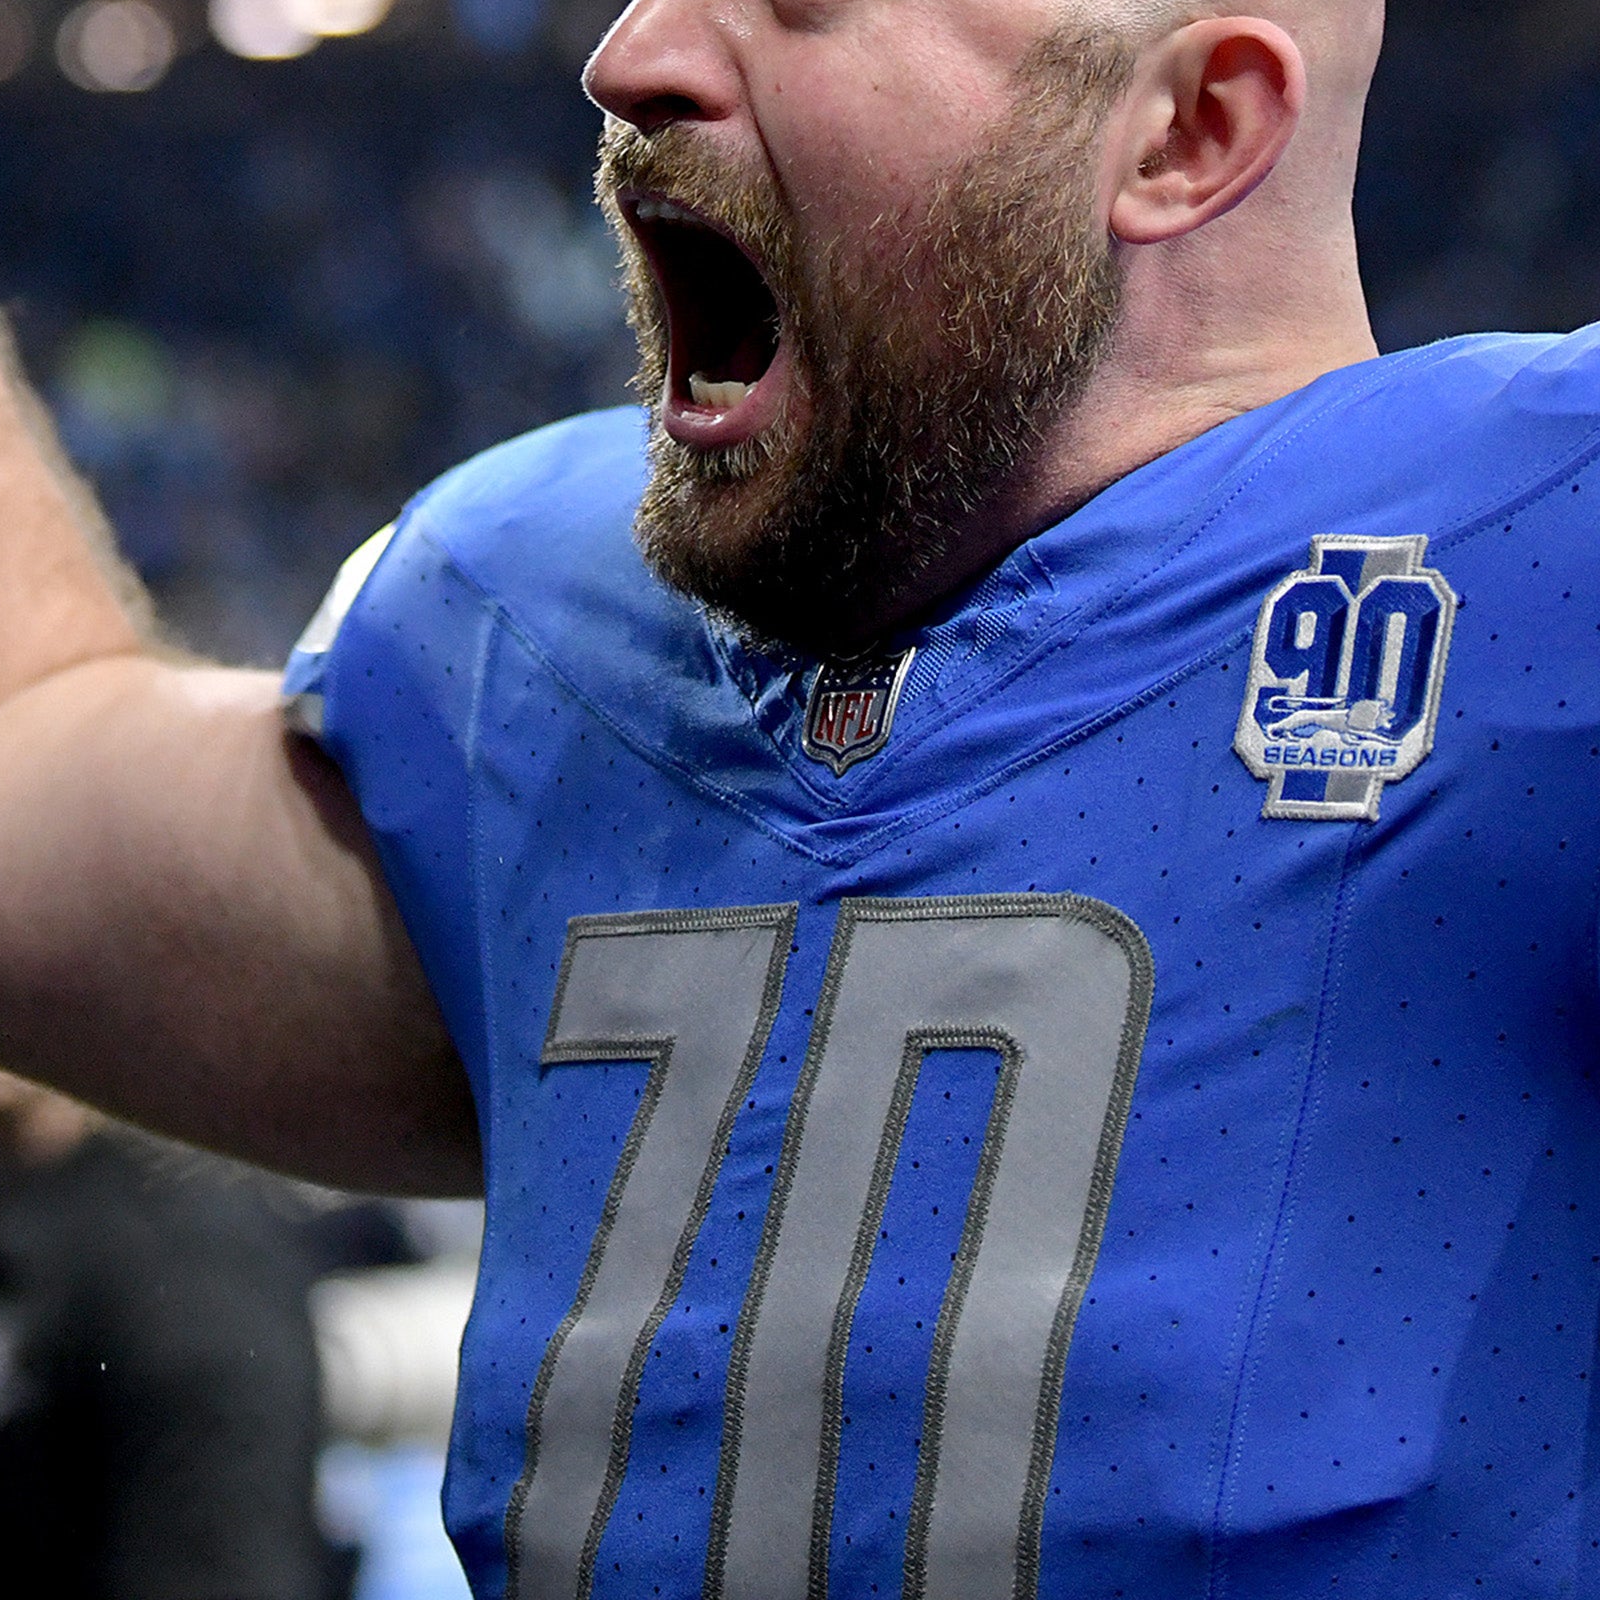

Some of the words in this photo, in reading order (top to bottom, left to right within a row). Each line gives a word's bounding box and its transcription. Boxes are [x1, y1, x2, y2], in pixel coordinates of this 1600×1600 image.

[1253, 578, 1441, 744] 90
[814, 691, 877, 746] NFL
[1262, 746, 1399, 768] SEASONS
[503, 890, 1156, 1600] 70
